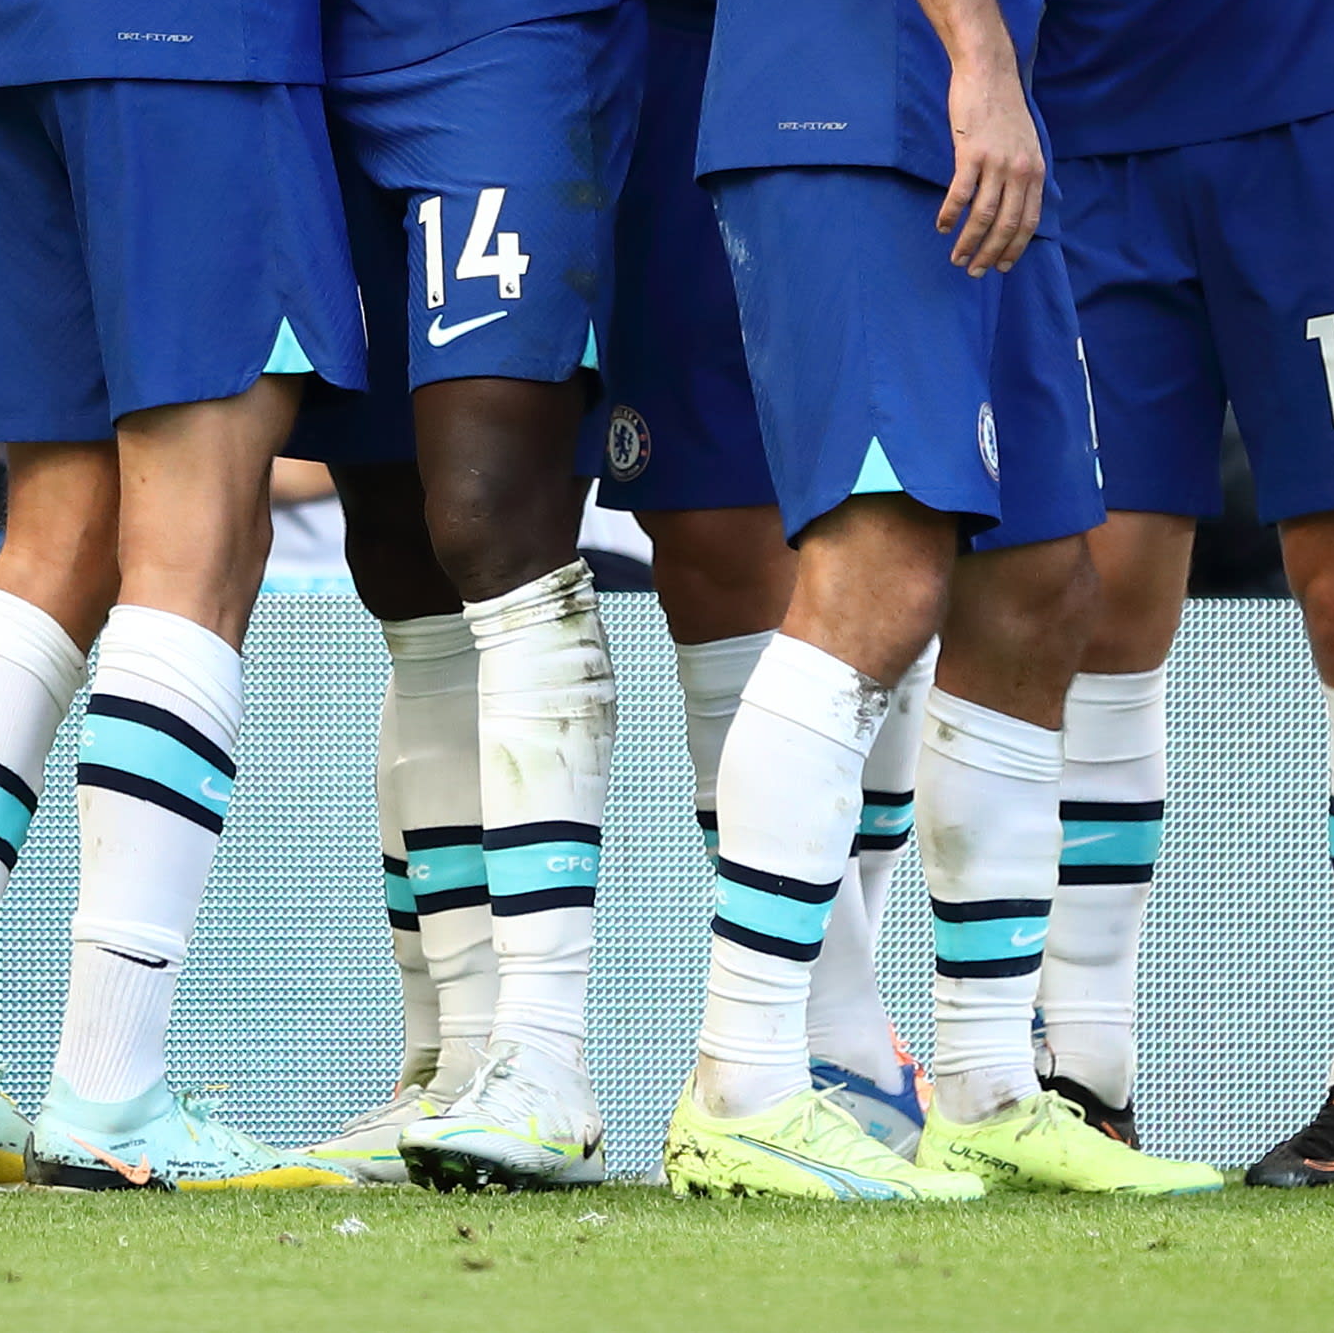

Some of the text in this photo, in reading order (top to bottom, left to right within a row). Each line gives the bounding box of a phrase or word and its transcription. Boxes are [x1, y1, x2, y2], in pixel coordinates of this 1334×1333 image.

[418, 187, 531, 310] 14
[546, 855, 595, 873] CFC
[948, 1142, 1020, 1177] ULTRA
